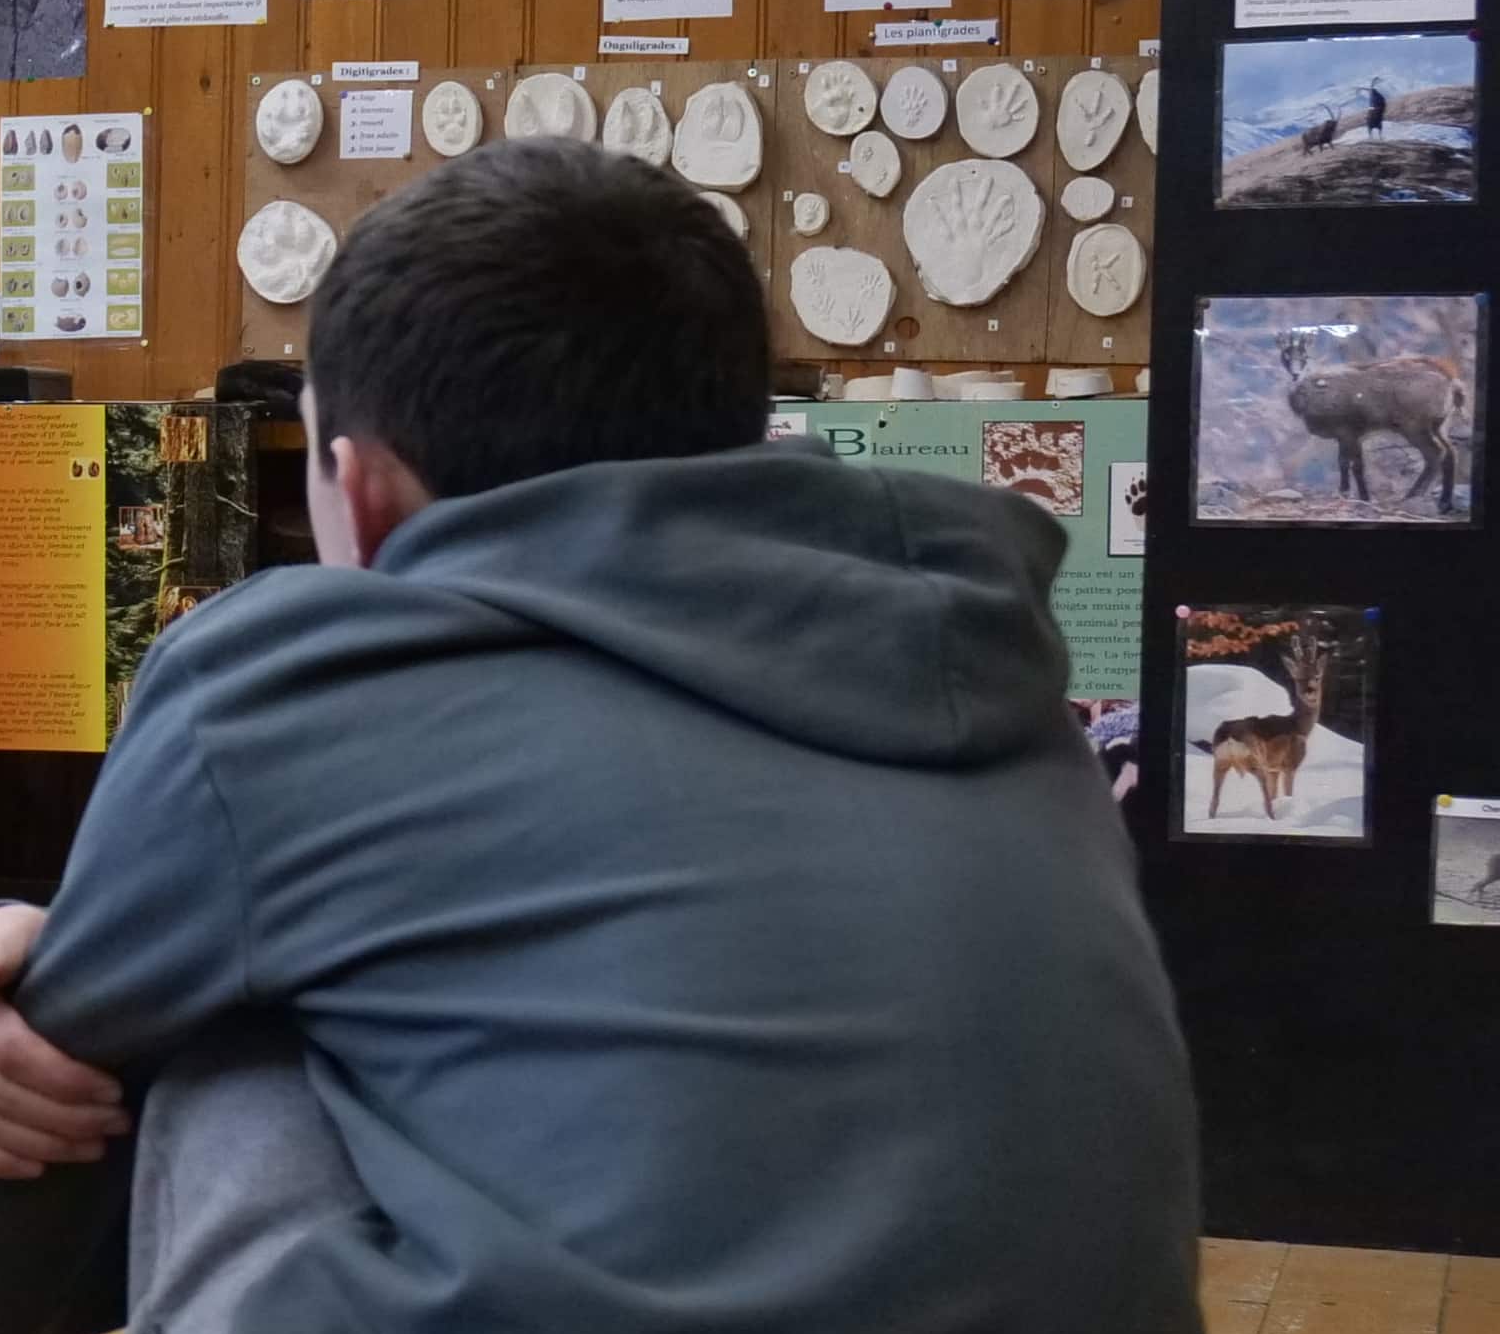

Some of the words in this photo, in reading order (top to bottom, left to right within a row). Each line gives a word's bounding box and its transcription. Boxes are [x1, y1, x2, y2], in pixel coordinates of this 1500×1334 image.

[885, 29, 903, 39] Les
[907, 25, 981, 39] plantigrades
[824, 428, 969, 457] Blaireau
